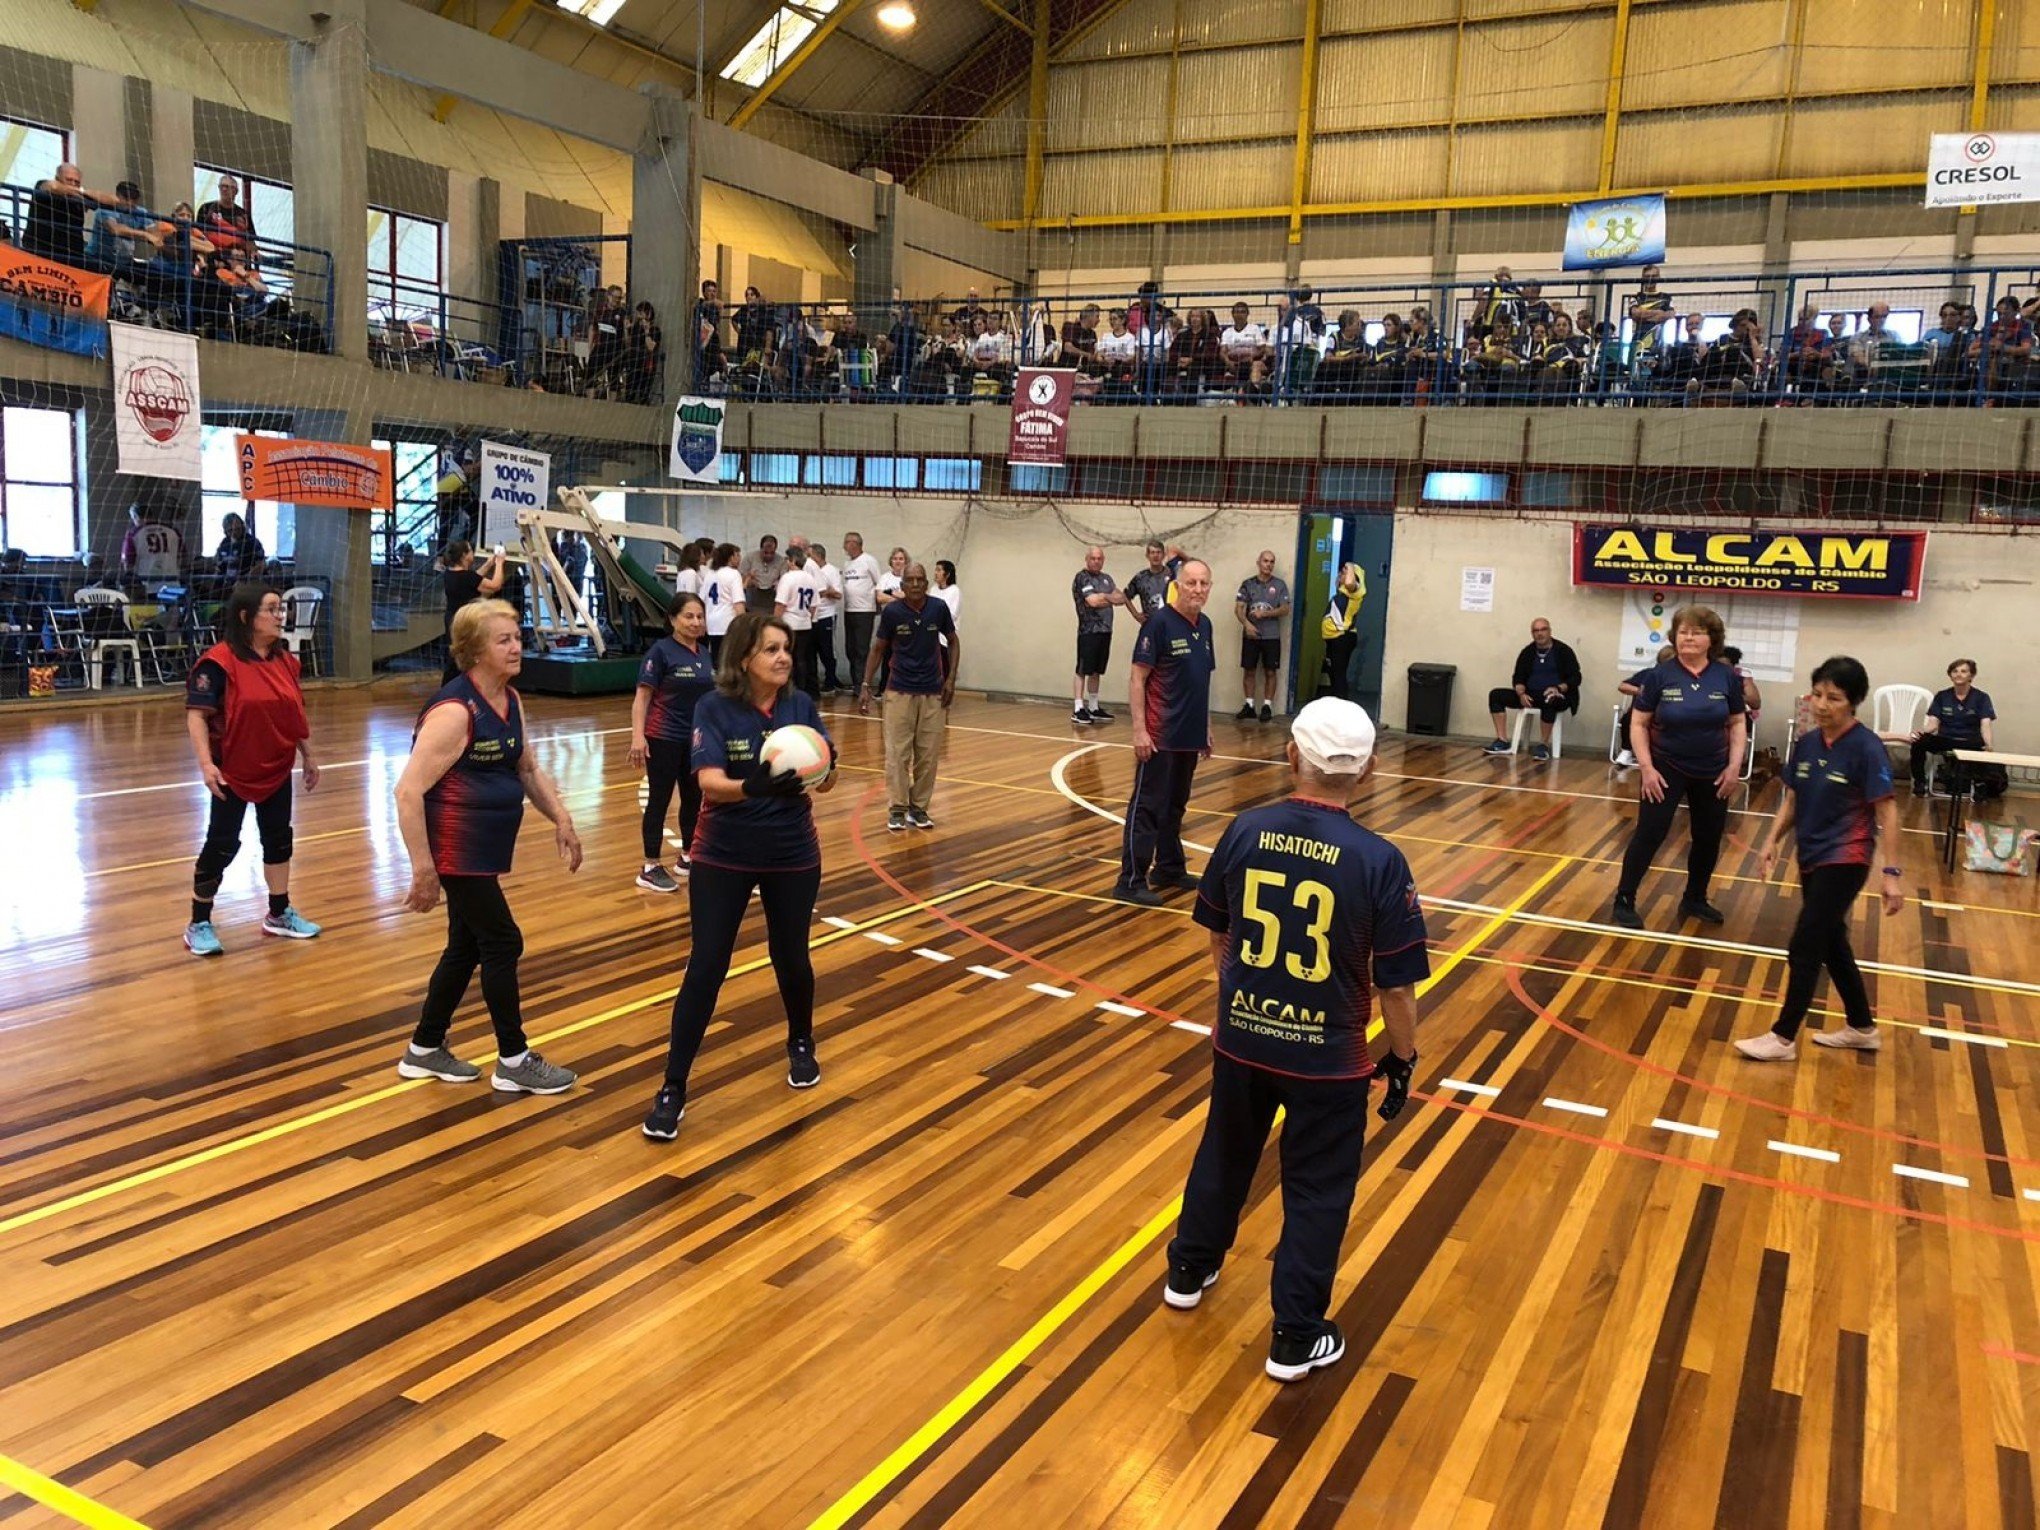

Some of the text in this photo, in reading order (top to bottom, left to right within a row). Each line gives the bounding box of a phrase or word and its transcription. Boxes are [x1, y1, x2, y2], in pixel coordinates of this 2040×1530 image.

[1934, 165, 2021, 185] CRESOL
[7, 265, 32, 278] SEM
[126, 390, 190, 415] ASSCAM
[487, 449, 508, 461] GRUPO
[510, 453, 518, 462] DE
[495, 464, 535, 484] 100%
[491, 486, 536, 507] ATIVO
[147, 532, 168, 555] 91
[1594, 530, 1890, 571] ALCAM
[1594, 560, 1887, 580] Associação Leopoldense de Câmbio
[1628, 571, 1669, 585] SÃO
[1675, 574, 1782, 590] LEOPOLDO
[1812, 580, 1840, 592] RS
[708, 582, 719, 605] 4
[798, 587, 814, 610] 13
[1258, 831, 1341, 866] HISATOCHI
[1240, 867, 1336, 983] 53
[1231, 989, 1326, 1024] ALCAM
[1229, 1016, 1248, 1030] SÃO
[1249, 1023, 1302, 1043] LEOPOLDO
[1308, 1034, 1325, 1044] RS
